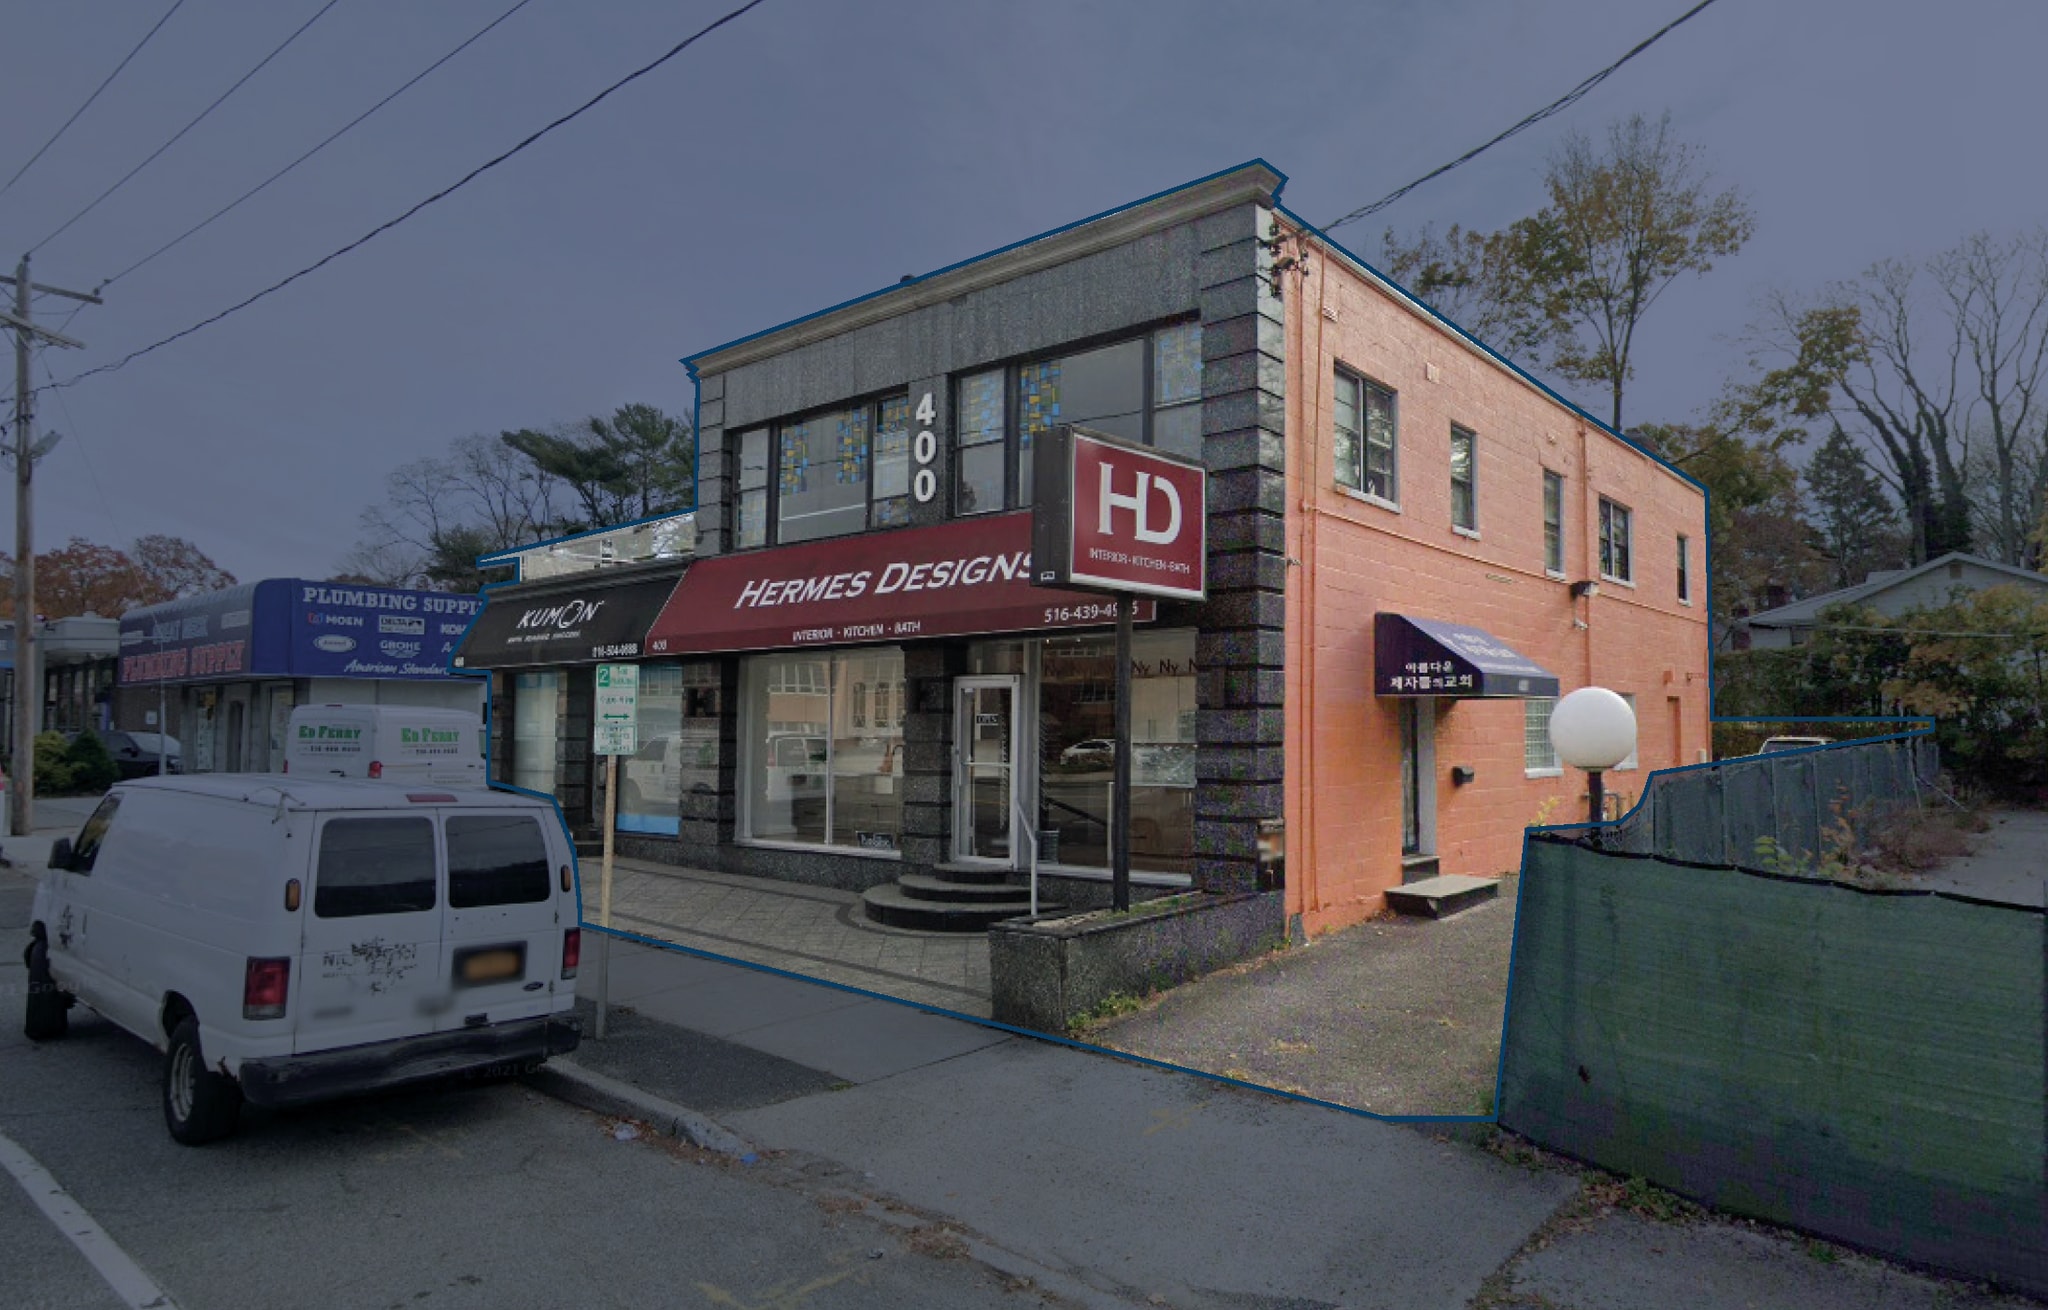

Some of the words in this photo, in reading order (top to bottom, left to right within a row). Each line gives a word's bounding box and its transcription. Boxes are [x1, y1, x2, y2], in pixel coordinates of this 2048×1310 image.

[915, 391, 937, 502] 400
[1097, 462, 1182, 545] HD
[733, 571, 872, 609] HERMES
[875, 551, 1032, 594] DESIGNS
[302, 587, 417, 612] PLUMBING
[423, 597, 484, 616] SUPPL
[516, 600, 605, 628] KUMON
[326, 615, 363, 626] MOEN
[792, 627, 833, 642] INTERIOR
[843, 623, 883, 638] KITCHEN
[894, 620, 920, 634] BATH
[380, 640, 421, 651] GROHE
[599, 669, 609, 683] 2
